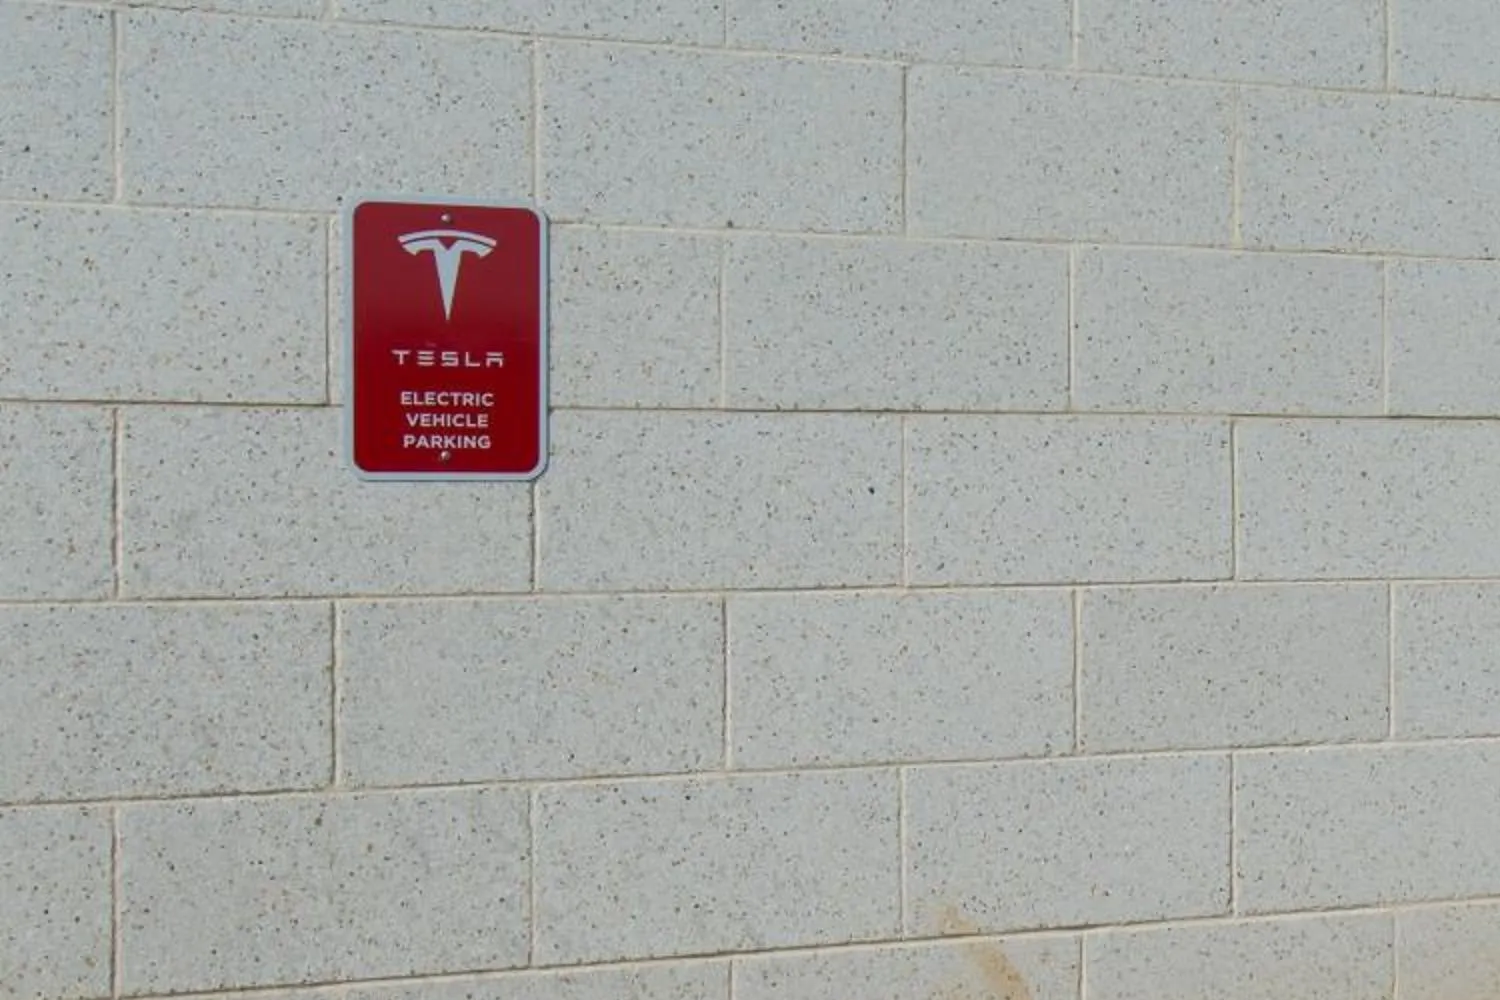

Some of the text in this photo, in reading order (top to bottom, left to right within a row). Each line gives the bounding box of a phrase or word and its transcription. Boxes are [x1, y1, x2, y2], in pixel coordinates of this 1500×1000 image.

[391, 350, 504, 368] TESLA
[399, 391, 494, 407] ELECTRIC
[405, 413, 489, 427] VEHICLE
[403, 435, 491, 449] PARKING
